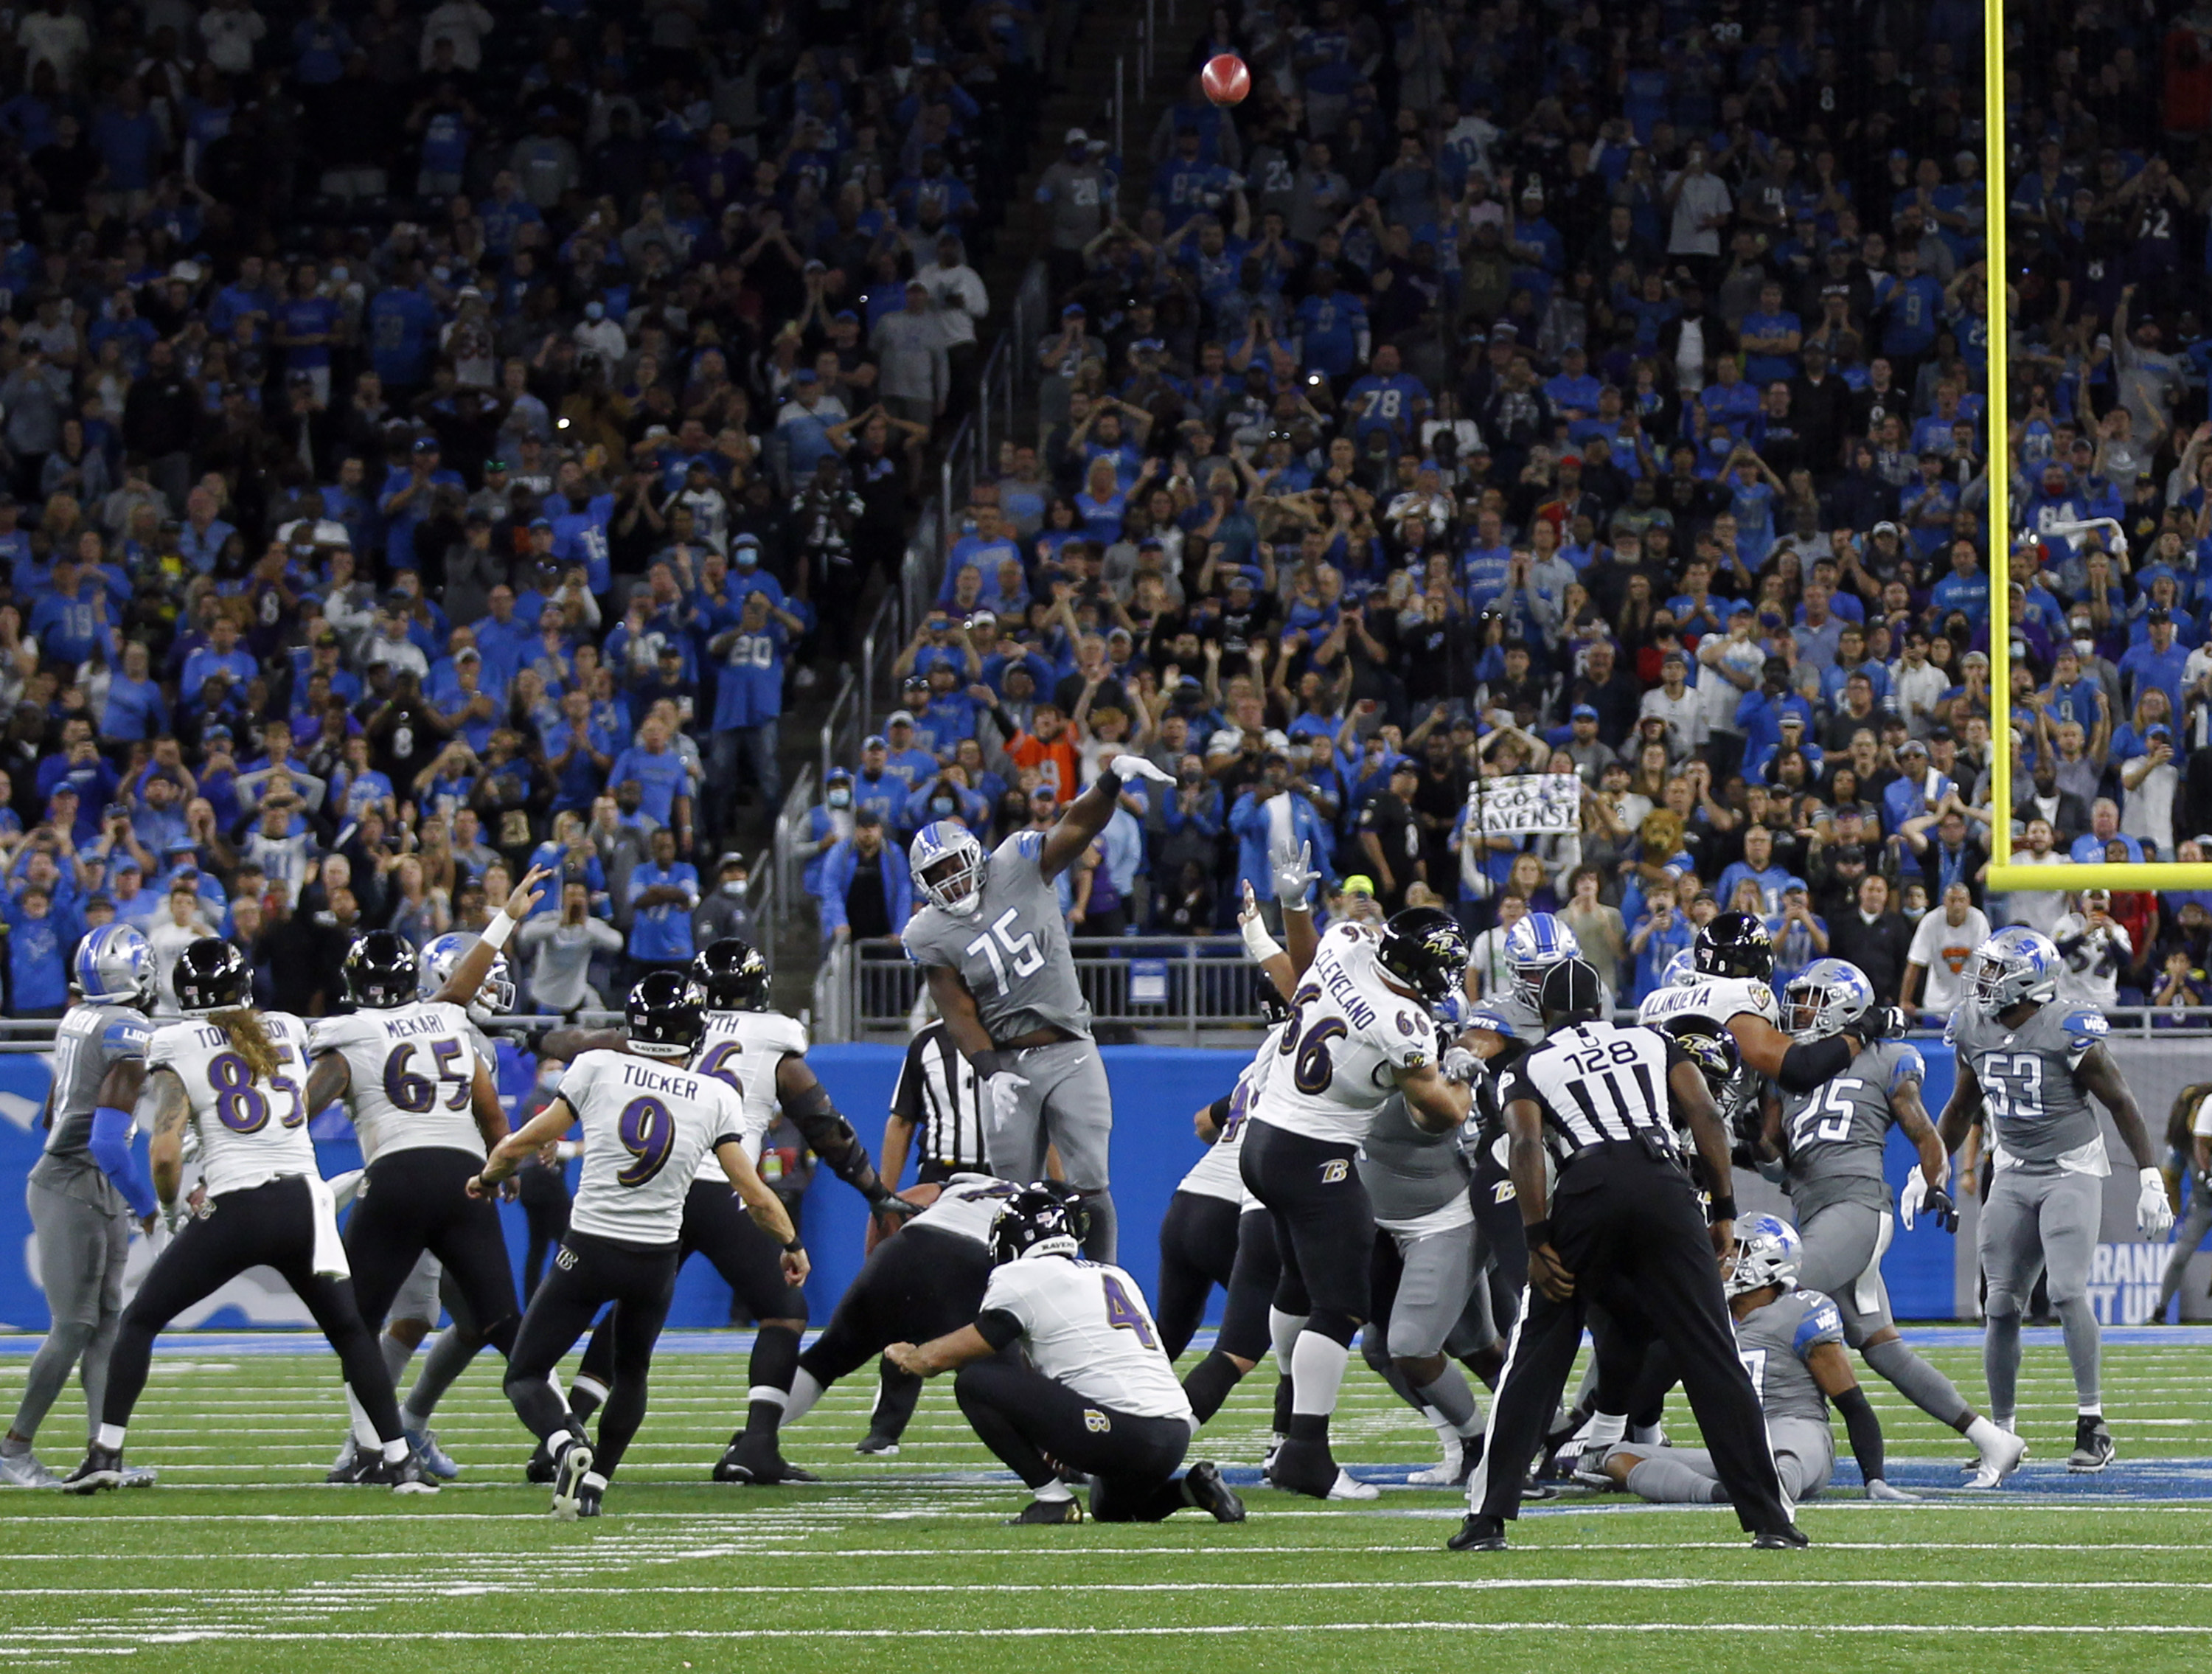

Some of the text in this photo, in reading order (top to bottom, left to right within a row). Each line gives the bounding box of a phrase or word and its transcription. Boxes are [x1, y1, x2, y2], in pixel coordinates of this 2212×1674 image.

[1820, 86, 1835, 111] 8
[1364, 387, 1402, 420] 78
[260, 590, 280, 627] 8
[730, 633, 773, 669] 20
[393, 726, 413, 760] 8
[1476, 806, 1575, 830] AVENS!
[1494, 791, 1526, 809] GO
[966, 906, 1046, 997] 75
[1313, 948, 1377, 1032] CLEVELAND
[383, 1013, 445, 1039] MEKARI
[655, 1027, 664, 1039] 9
[1279, 982, 1349, 1096] 66
[1396, 1010, 1430, 1037] 66
[634, 1043, 673, 1054] RAVENS
[1562, 1039, 1639, 1075] 128
[207, 1043, 305, 1134] 85
[383, 1035, 473, 1114] 65
[624, 1063, 699, 1101] TUCKER
[1982, 1052, 2045, 1117] 53
[1790, 1077, 1864, 1150] 25
[616, 1094, 676, 1188] 9
[1040, 1240, 1075, 1254] RAVENS
[2086, 1243, 2177, 1283] RANK
[1100, 1271, 1157, 1350] 4
